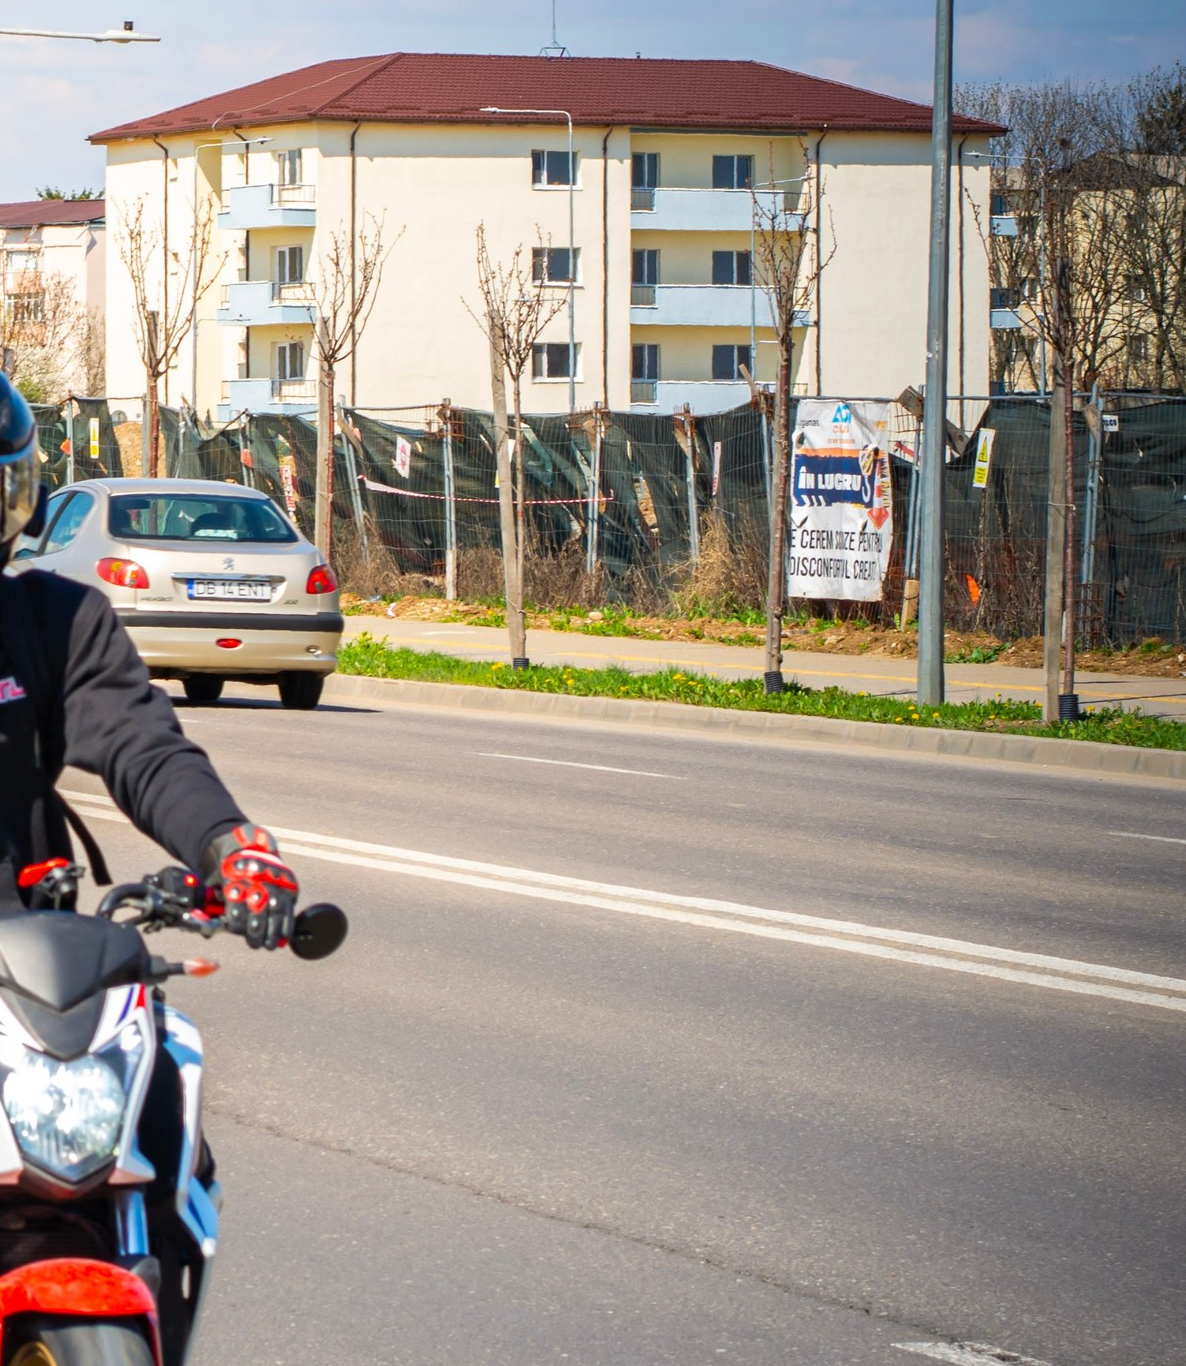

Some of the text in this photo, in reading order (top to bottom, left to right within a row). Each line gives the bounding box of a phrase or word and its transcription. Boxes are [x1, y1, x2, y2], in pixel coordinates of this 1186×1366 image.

[798, 466, 862, 491] ÎN LUCRU
[800, 529, 833, 550] CEREM
[196, 581, 266, 597] DB 14 ENT
